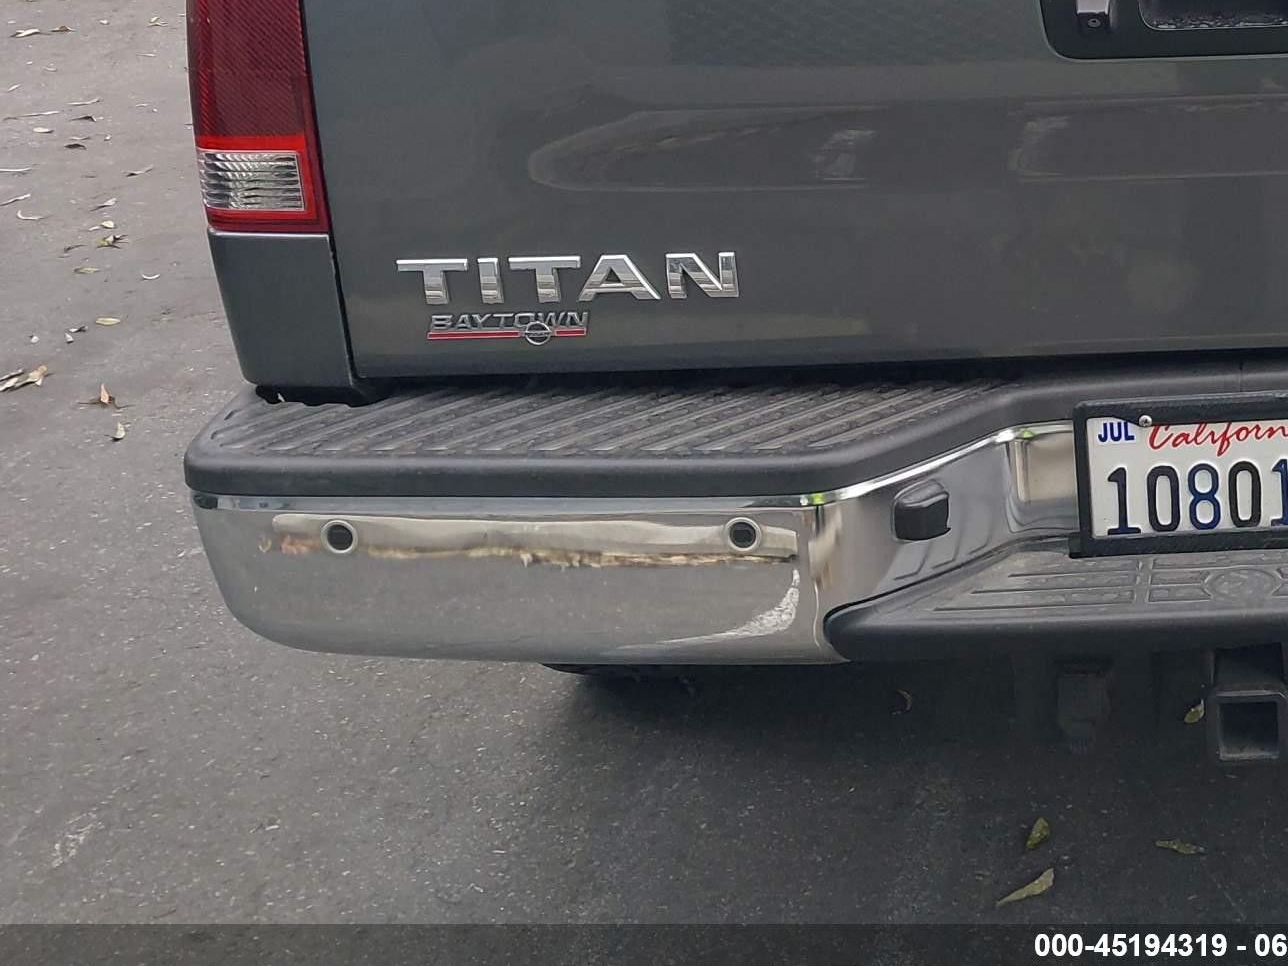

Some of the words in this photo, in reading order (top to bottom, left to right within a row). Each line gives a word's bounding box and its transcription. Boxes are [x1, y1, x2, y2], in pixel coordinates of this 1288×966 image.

[396, 251, 740, 306] TITAN
[430, 311, 589, 331] BAYTOWN
[1098, 421, 1135, 443] JUL
